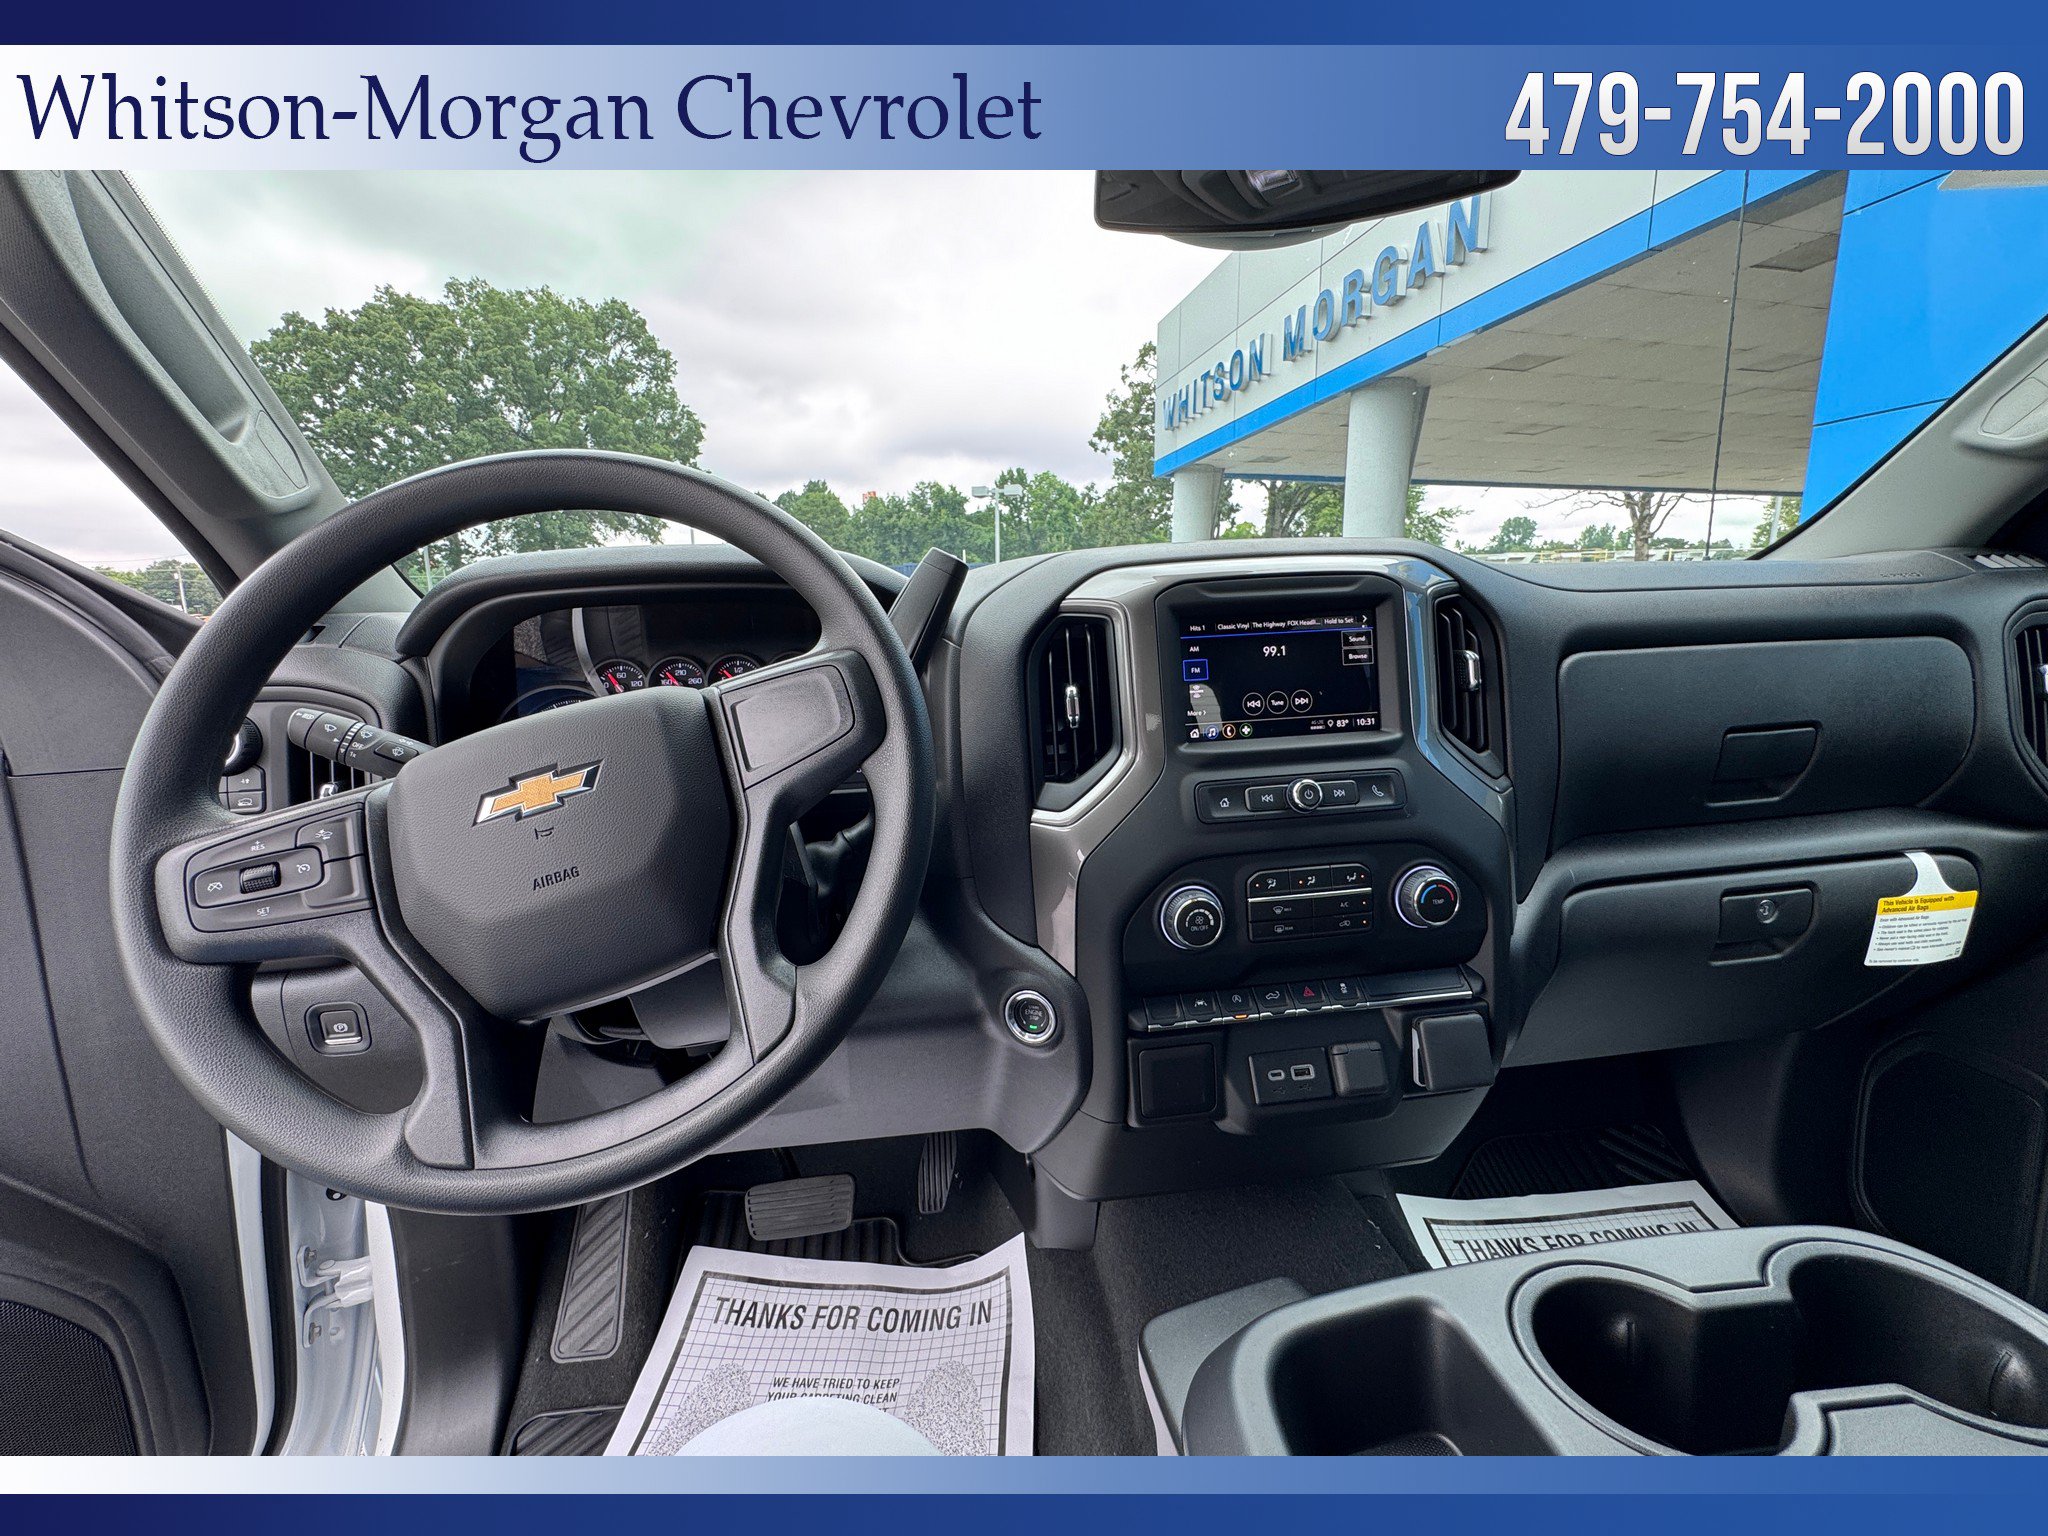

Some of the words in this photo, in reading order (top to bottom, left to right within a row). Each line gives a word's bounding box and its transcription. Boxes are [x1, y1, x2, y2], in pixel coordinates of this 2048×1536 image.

[1163, 333, 1272, 431] WHITSON
[1283, 192, 1490, 362] MORGAN
[1236, 622, 1250, 631] Vinyl
[1263, 621, 1286, 629] Highway
[1263, 645, 1286, 657] 99.1
[1356, 718, 1375, 726] 10:31
[352, 741, 364, 750] OFF
[251, 843, 265, 851] RES
[533, 866, 580, 891] AIRBAG
[1920, 896, 1943, 904] Equipped
[256, 906, 270, 915] SET
[1025, 1009, 1043, 1017] ENGINE
[1453, 1236, 1537, 1263] THANKS
[1541, 1232, 1586, 1251] FOR
[713, 1297, 806, 1330] THANKS
[811, 1305, 859, 1331] FOR
[867, 1306, 962, 1334] COMING
[970, 1300, 993, 1326] IN
[772, 1377, 790, 1388] WE
[791, 1377, 820, 1389] HAVE
[822, 1378, 854, 1390] TRIED
[857, 1378, 871, 1390] TO
[873, 1378, 900, 1390] KEEP
[767, 1392, 797, 1403] YOUR
[863, 1391, 898, 1405] CLEAN
